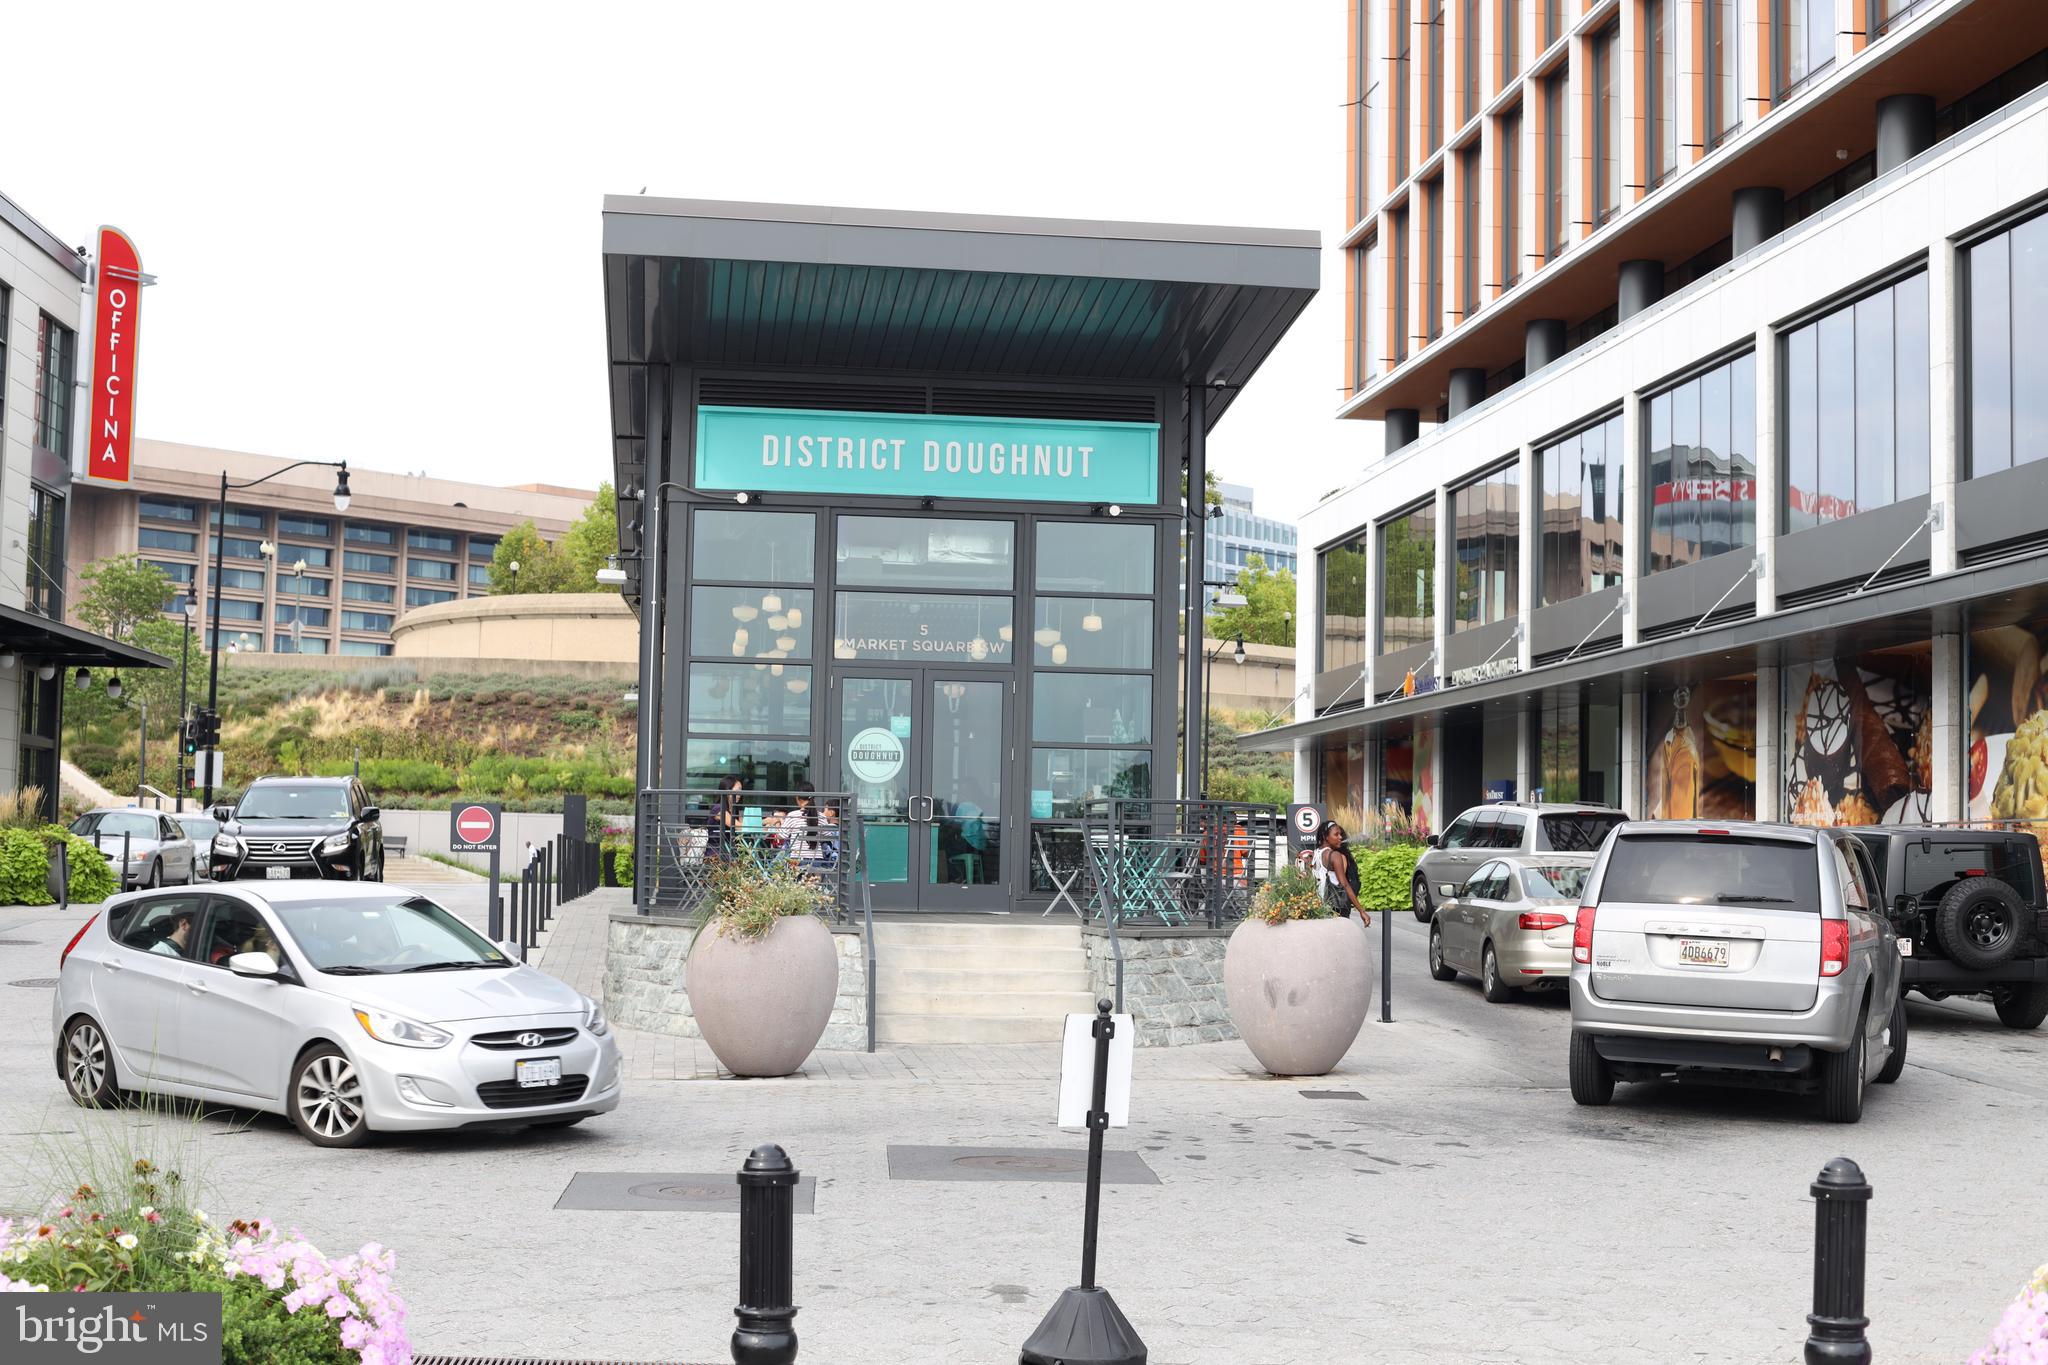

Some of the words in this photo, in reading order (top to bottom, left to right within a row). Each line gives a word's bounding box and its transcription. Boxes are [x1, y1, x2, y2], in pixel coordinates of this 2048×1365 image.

[102, 288, 127, 463] OFFICINA
[762, 434, 906, 471] DISTRICT
[922, 439, 1094, 478] DOUGHNUT
[919, 624, 929, 636] 5
[844, 637, 908, 651] MARKET
[852, 751, 899, 761] DOUGHNUT
[1302, 812, 1313, 828] 5
